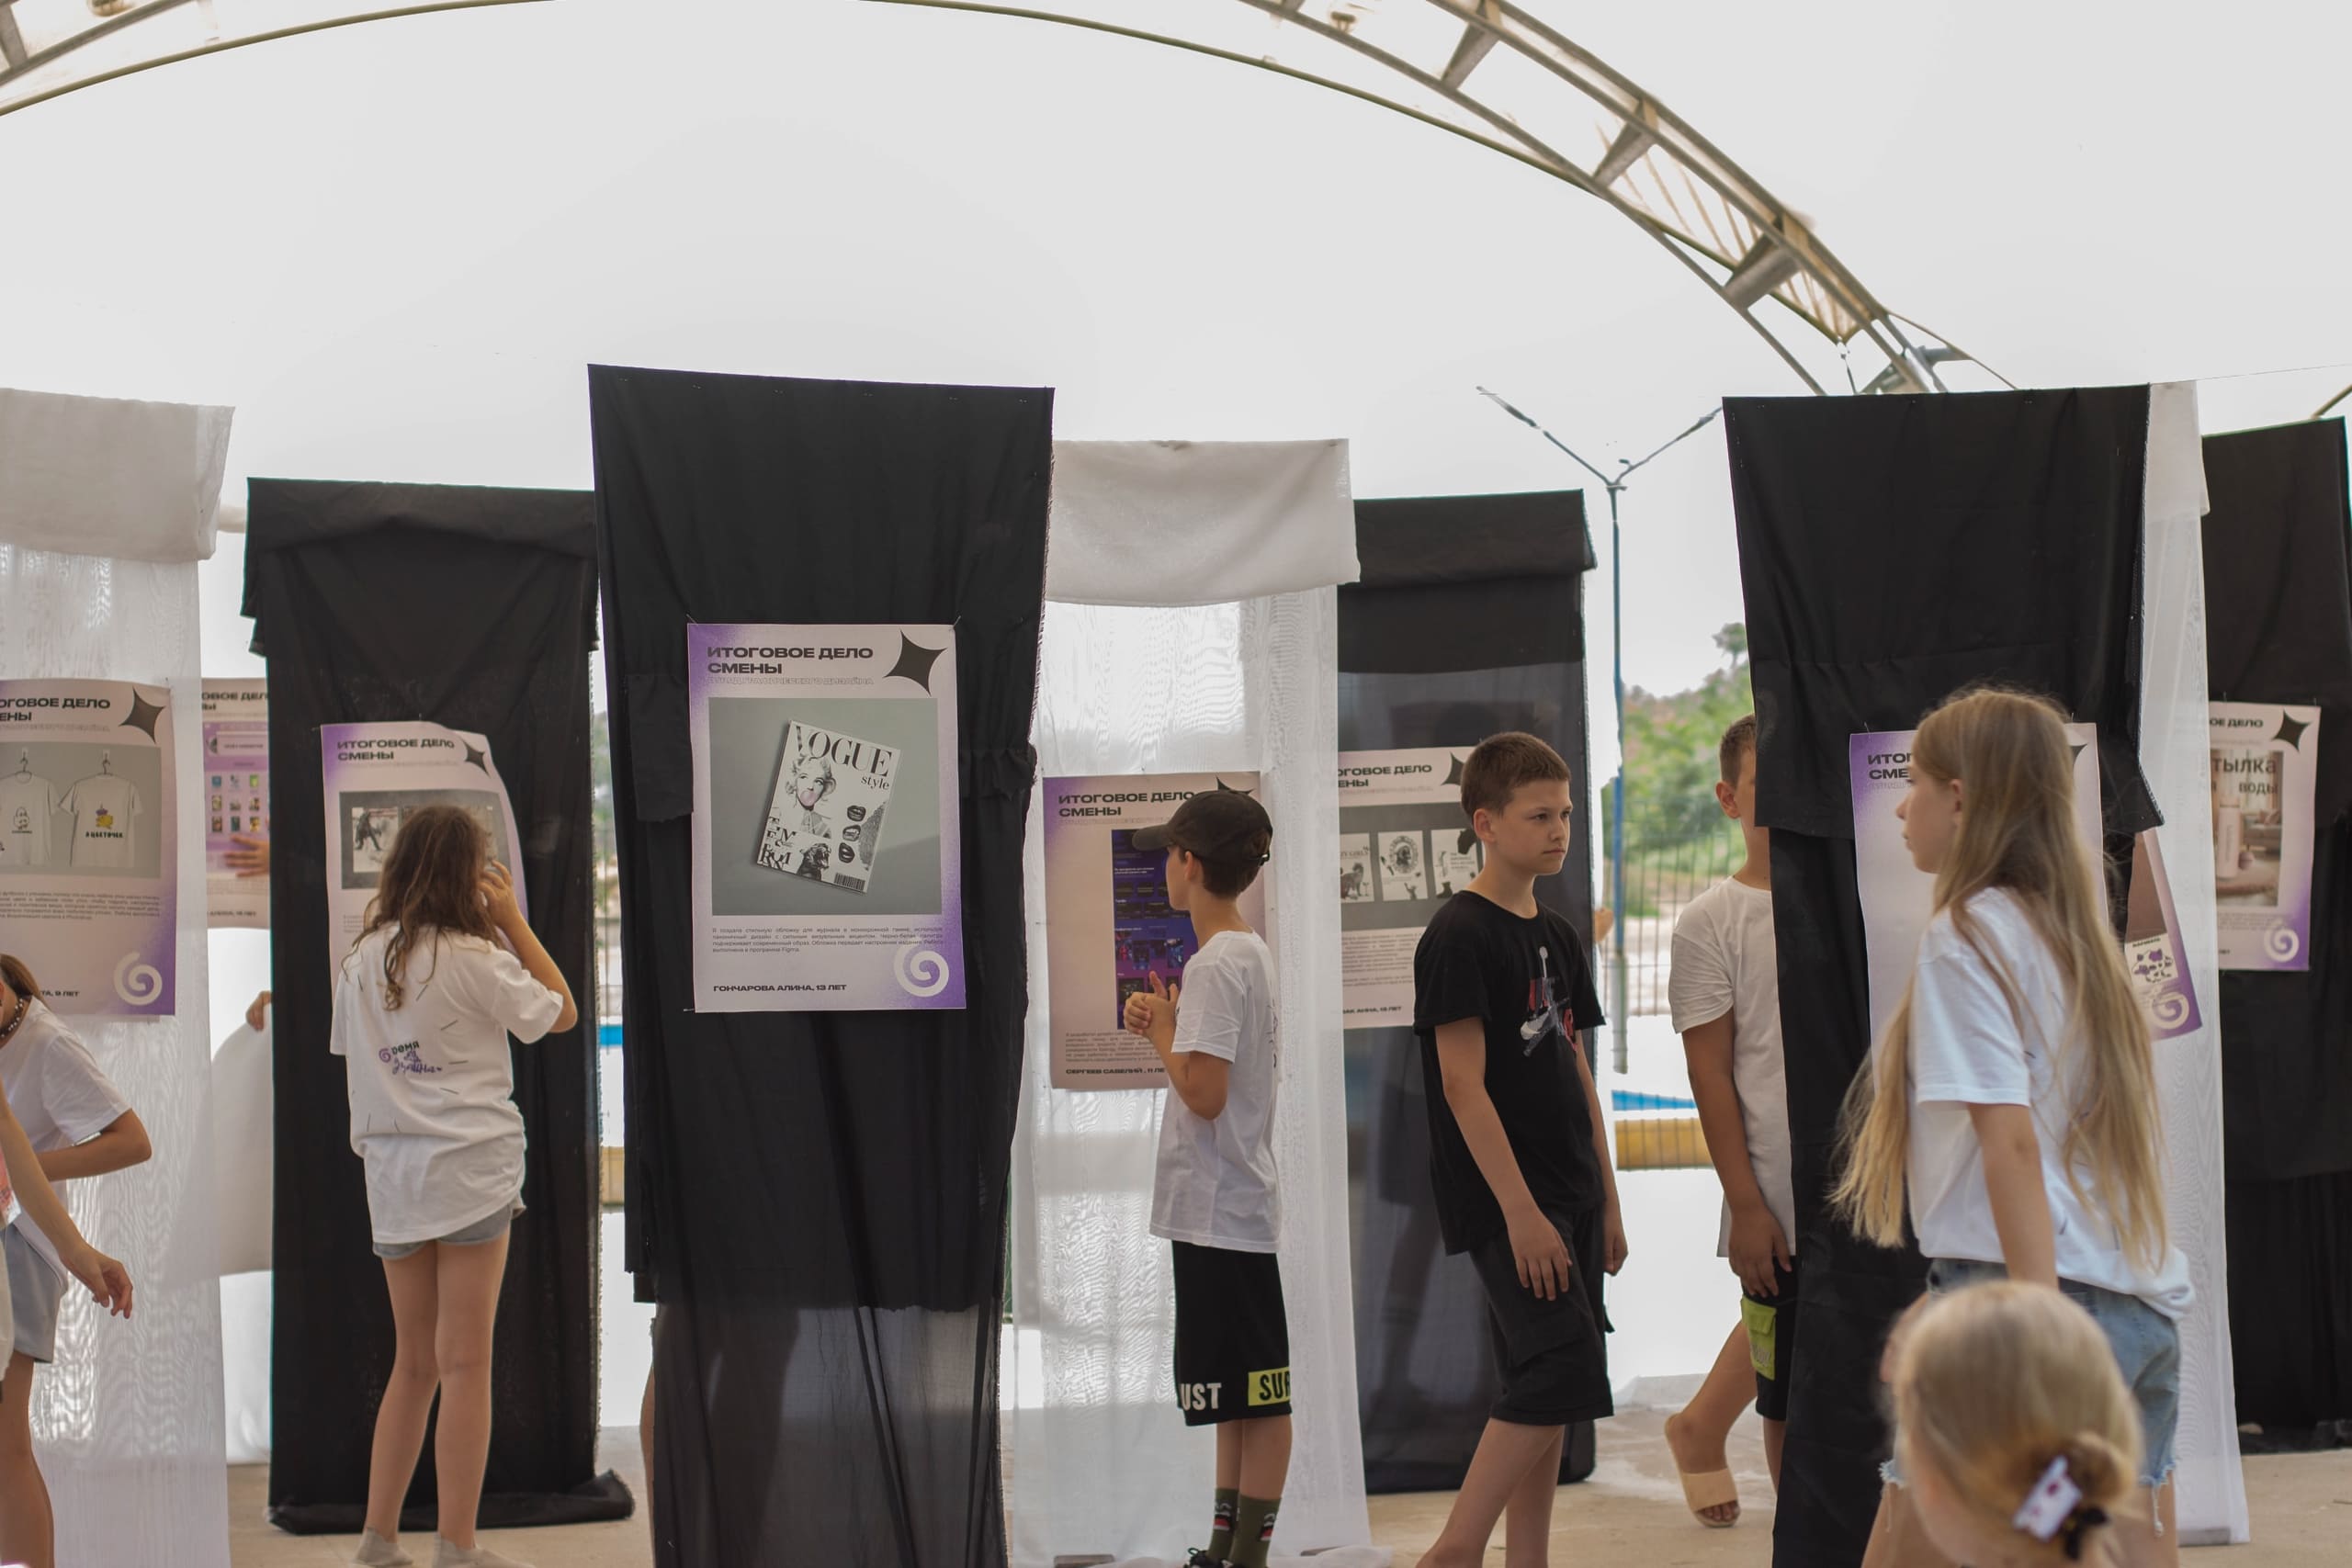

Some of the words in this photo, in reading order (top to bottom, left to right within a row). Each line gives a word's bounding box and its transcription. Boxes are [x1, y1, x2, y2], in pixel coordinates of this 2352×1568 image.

[707, 647, 815, 659] ИТОГОВОЕ
[819, 647, 874, 660] ДЕЛО
[708, 662, 783, 674] СМЕНЫ
[62, 698, 111, 709] ДЕЛО
[2227, 718, 2264, 728] ДЕЛО
[336, 739, 418, 750] ИТОГОВОЕ
[421, 738, 455, 749] ДЕЛО
[338, 751, 394, 761] СМЕНЫ
[796, 725, 892, 777] VOGUE
[1394, 764, 1432, 775] ДЕЛО
[861, 776, 890, 791] style
[1058, 793, 1148, 804] ИТОГОВОЕ
[1150, 792, 1195, 803] ДЕЛО
[1058, 807, 1121, 818] СМЕНЫ
[1180, 1382, 1222, 1411] UST
